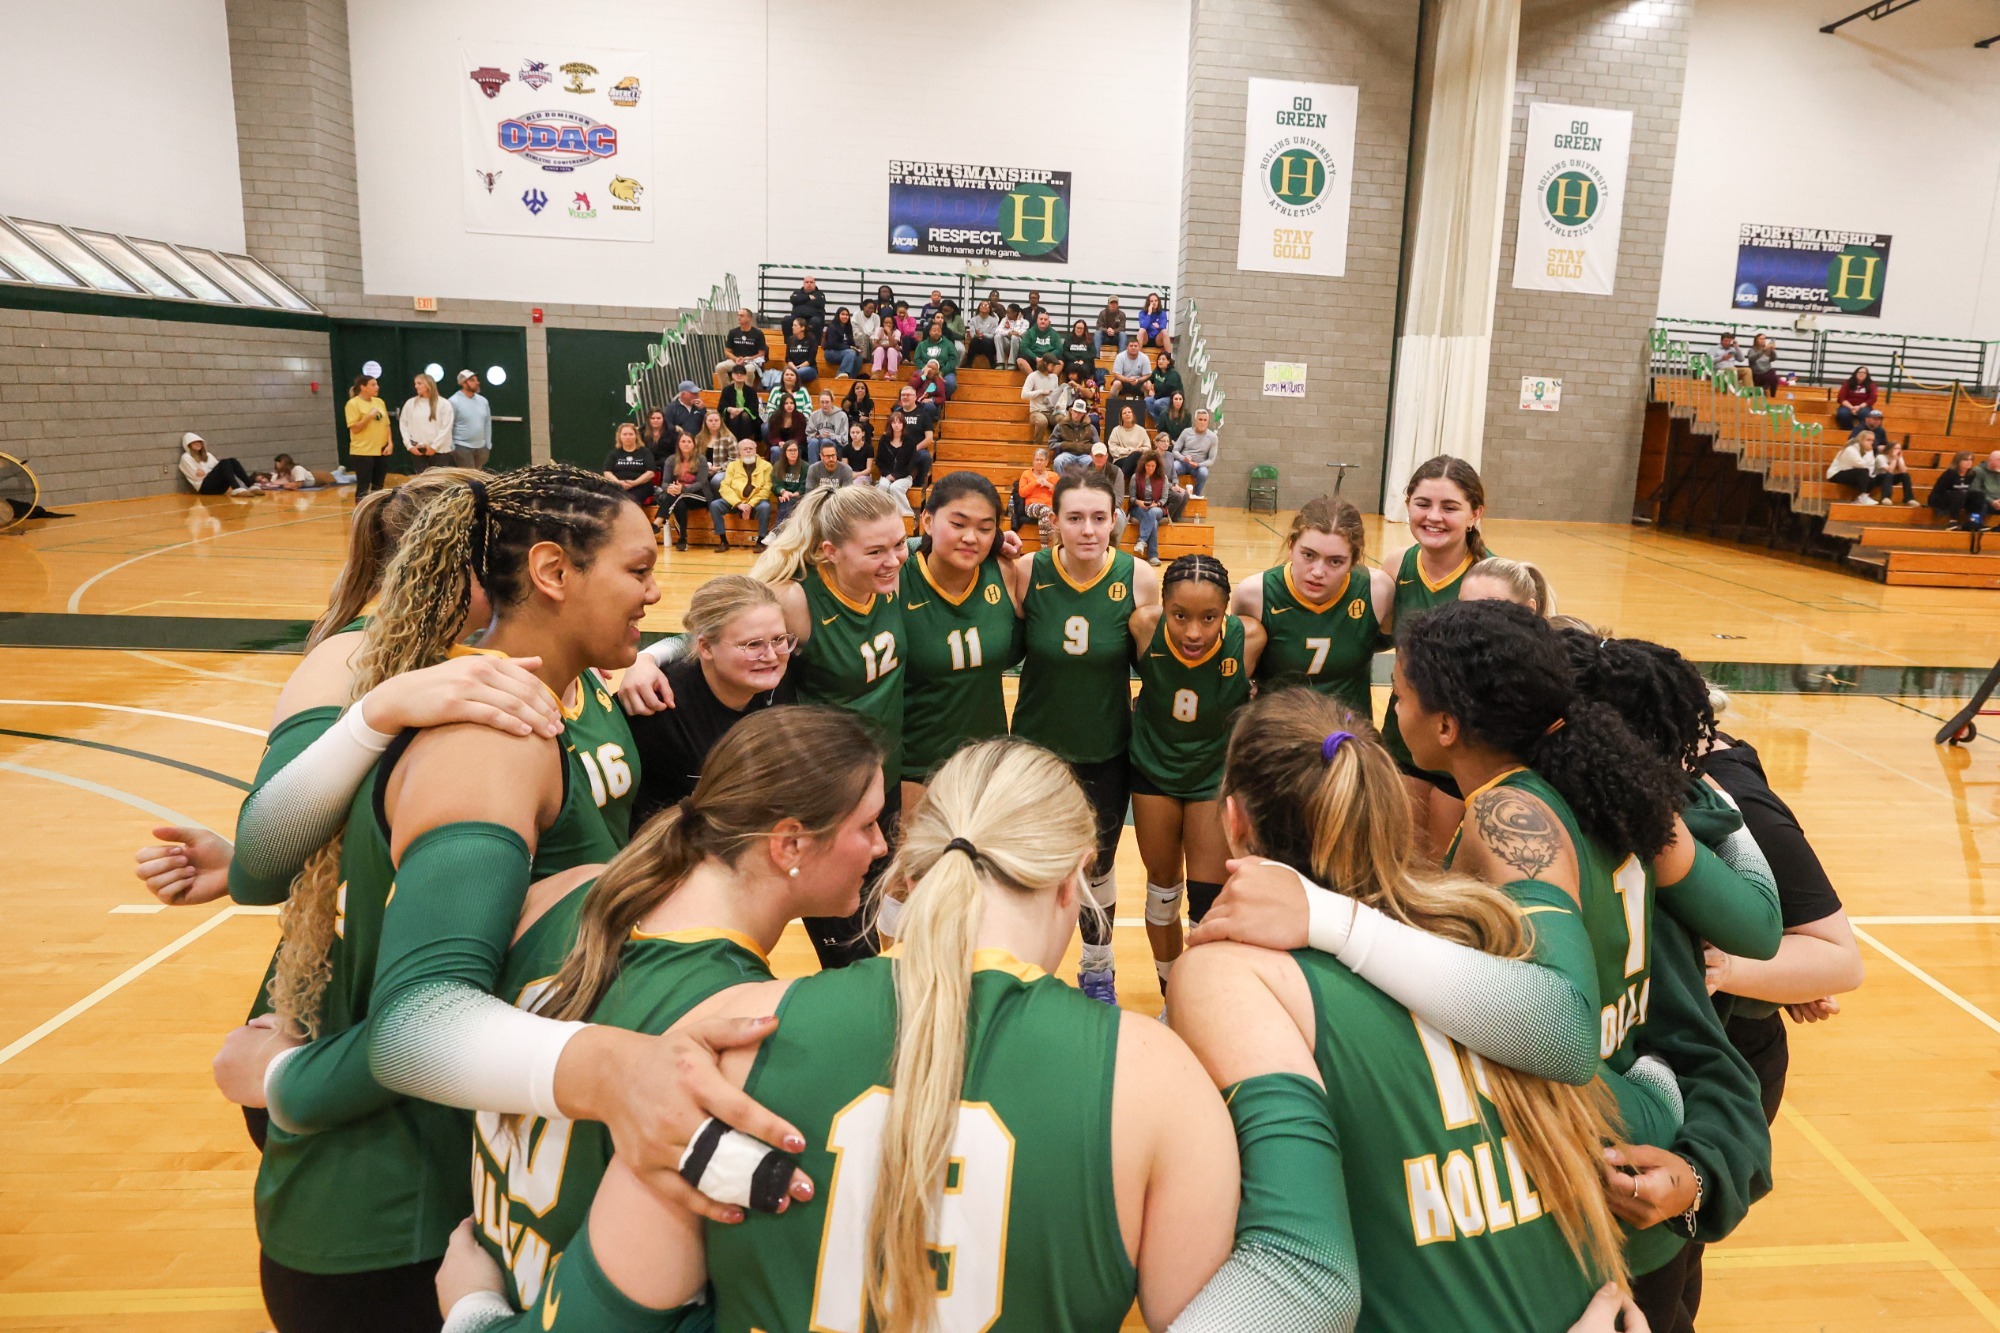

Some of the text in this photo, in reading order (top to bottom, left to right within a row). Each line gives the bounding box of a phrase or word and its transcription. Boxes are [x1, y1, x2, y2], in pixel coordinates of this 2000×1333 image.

[1294, 96, 1312, 111] GO
[526, 112, 590, 125] OLD DOMINION
[1276, 111, 1327, 128] GREEN
[1571, 121, 1588, 135] GO
[498, 119, 617, 158] ODAC
[1554, 134, 1602, 151] GREEN
[1260, 136, 1336, 175] HOLLINS UNIVERSITY
[890, 160, 1064, 185] SPORTSMANSHIP...
[1276, 156, 1320, 197] H
[1537, 159, 1608, 197] HOLLINS UNIVERSITY
[890, 175, 1016, 191] IT STARTS WITH YOU!
[1552, 178, 1594, 218] H
[1269, 199, 1322, 217] ATHLETICS
[1008, 194, 1061, 244] H
[928, 228, 1003, 246] RESPECT.
[1274, 229, 1313, 244] STAY
[1544, 220, 1594, 238] ATHLETICS
[892, 237, 918, 246] NCAA
[1740, 237, 1845, 252] IT STARTS WITH YOU!
[976, 247, 984, 255] of
[998, 250, 1021, 258] game.
[1273, 244, 1312, 260] GOLD
[1548, 248, 1585, 265] STAY
[1546, 265, 1583, 279] GOLD
[1833, 255, 1880, 300] H
[1766, 285, 1828, 302] RESPECT.
[417, 297, 432, 309] EXIT
[1111, 584, 1124, 600] H
[1062, 615, 1090, 656] 9
[860, 630, 898, 684] 12
[947, 626, 983, 671] 11
[1305, 637, 1332, 675] 7
[1172, 688, 1199, 723] 8
[578, 741, 632, 808] 16
[1403, 1133, 1552, 1247] HOLL
